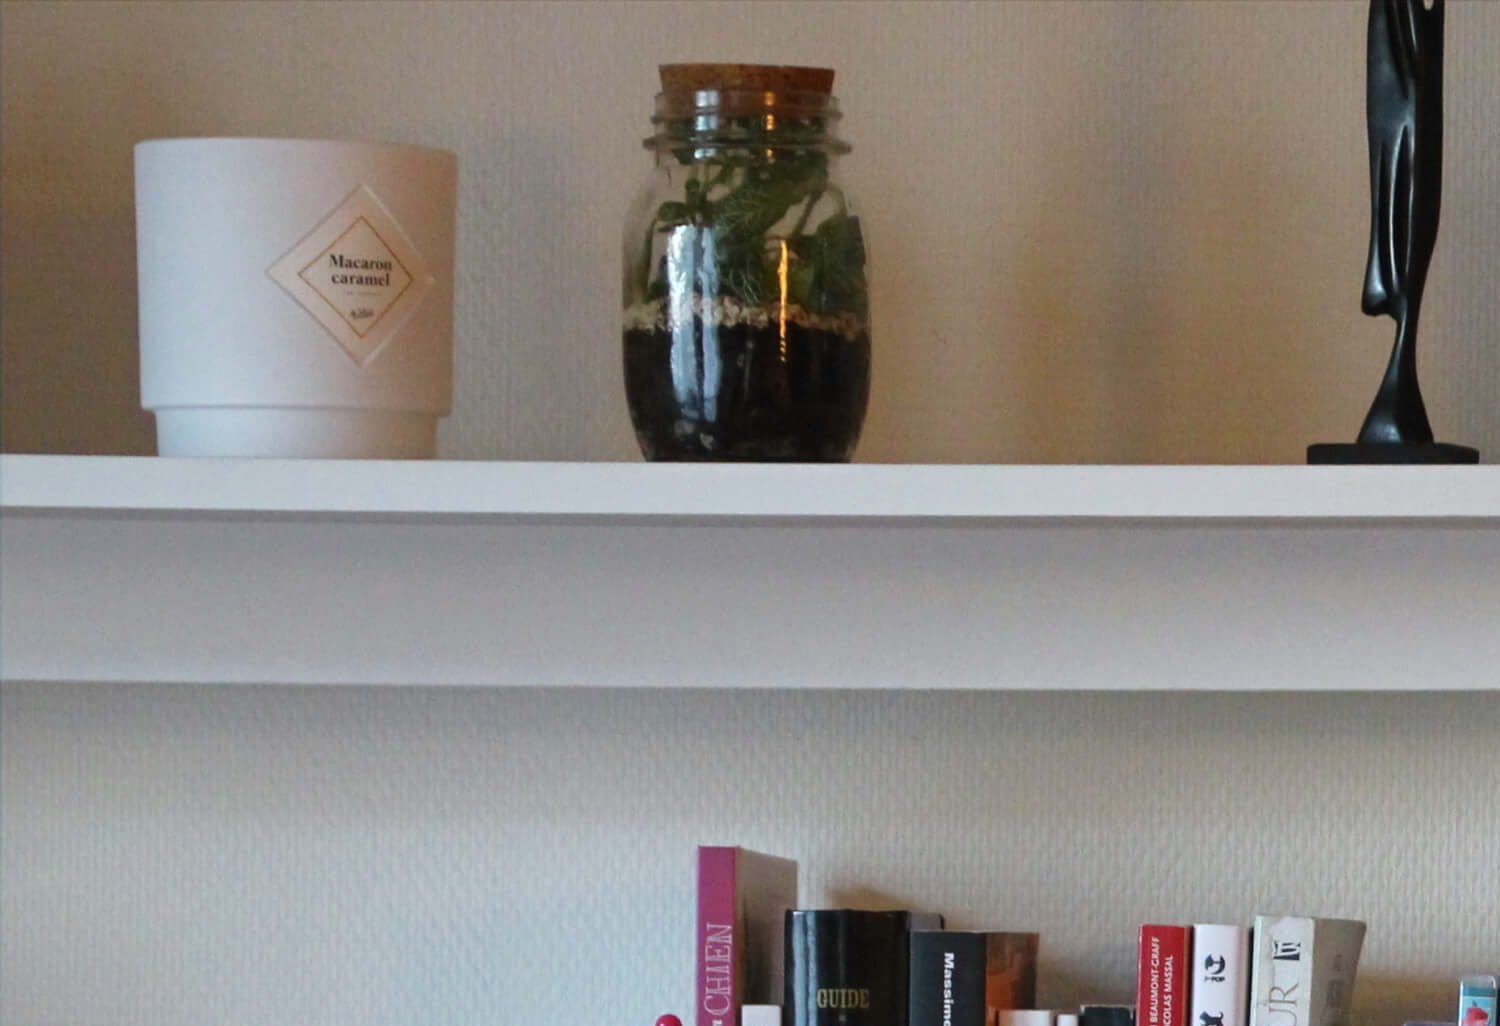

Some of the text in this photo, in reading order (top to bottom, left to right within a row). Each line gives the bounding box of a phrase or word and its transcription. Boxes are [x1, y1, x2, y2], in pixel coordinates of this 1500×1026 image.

[329, 253, 392, 271] Macaron
[331, 273, 390, 287] caramel
[704, 923, 734, 1016] CHIEN
[1150, 937, 1160, 1023] BEAUMONT-GRAFF
[1164, 956, 1174, 992] MASSAL
[817, 988, 870, 1009] GUIDE
